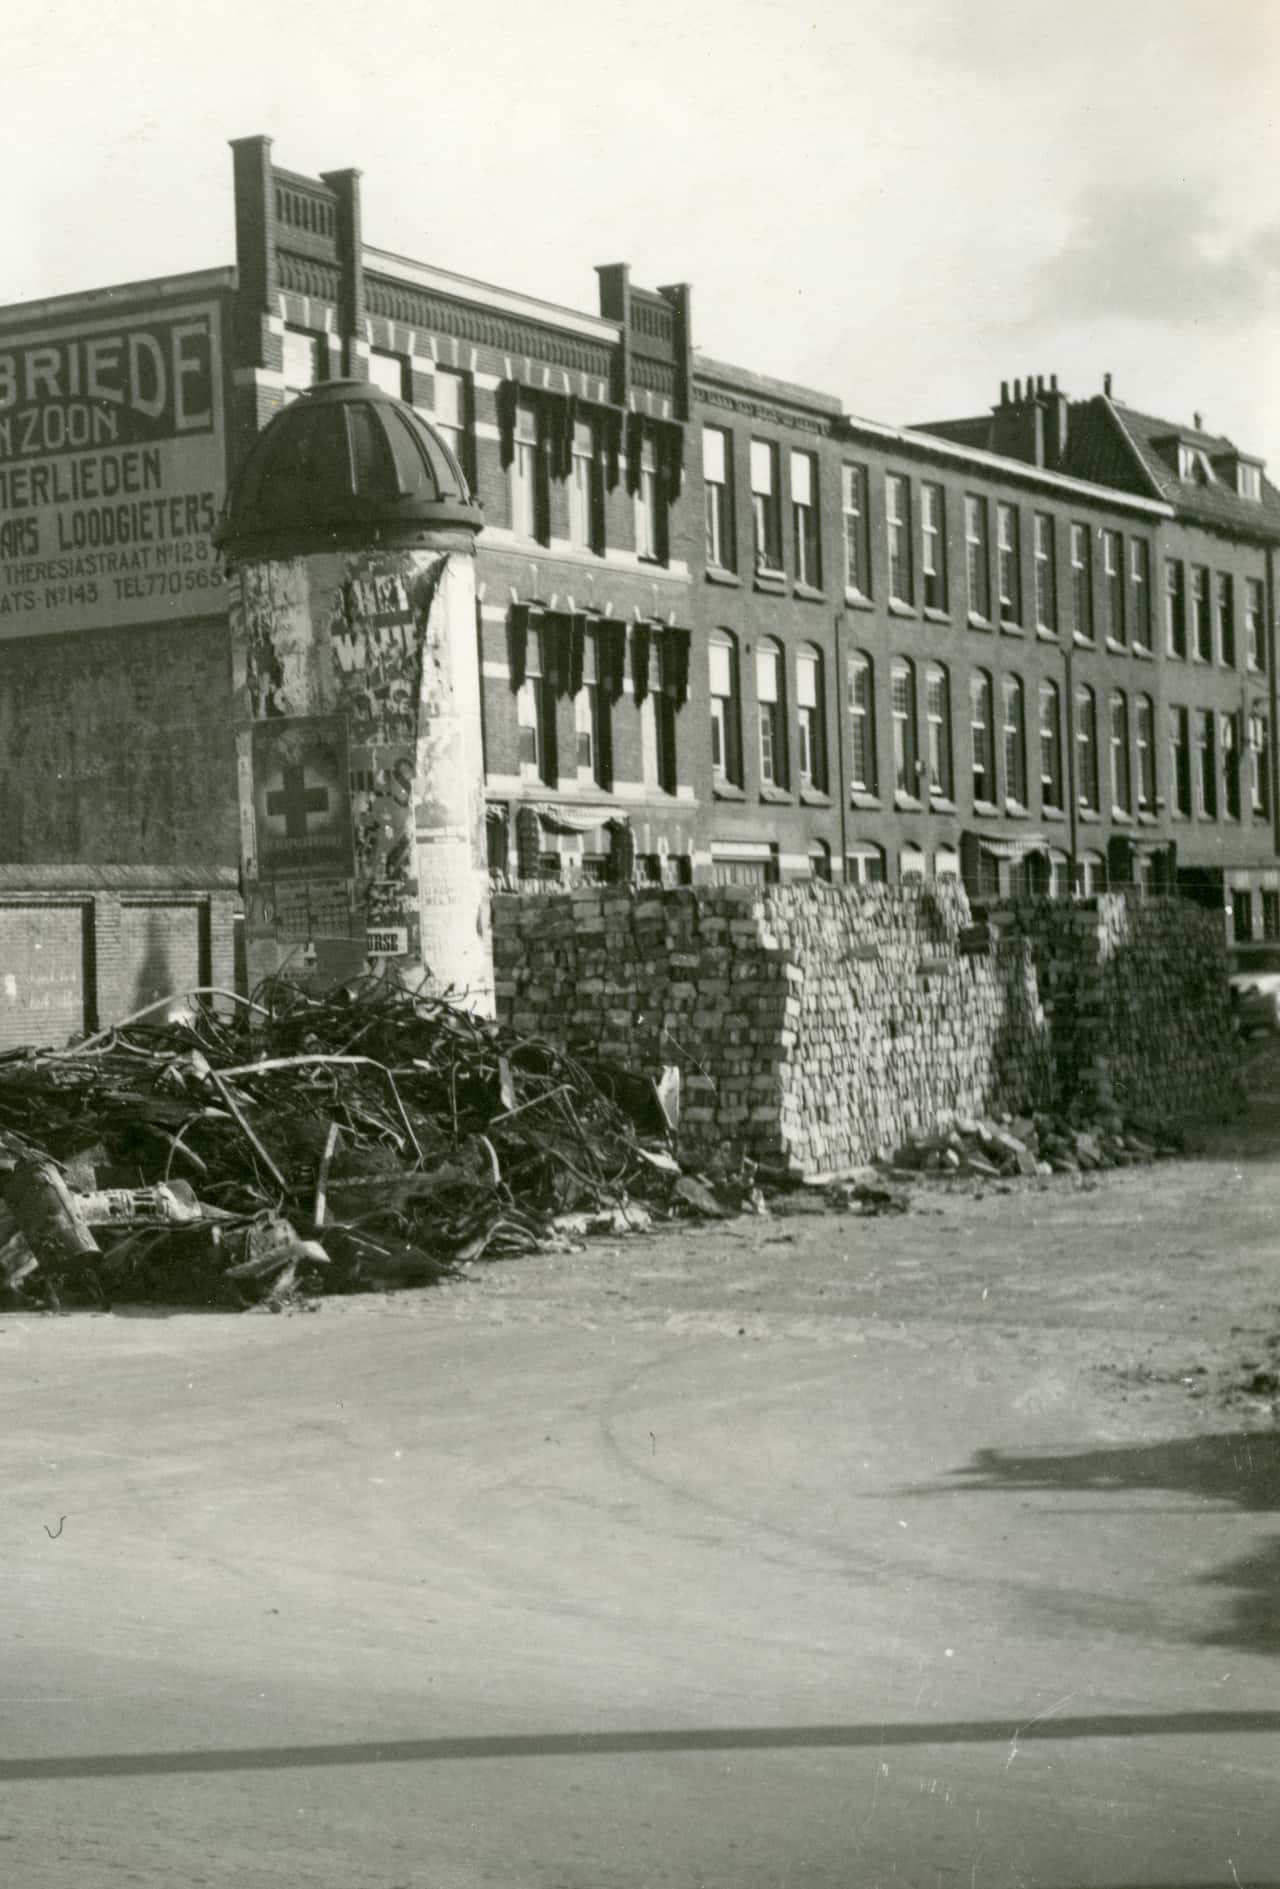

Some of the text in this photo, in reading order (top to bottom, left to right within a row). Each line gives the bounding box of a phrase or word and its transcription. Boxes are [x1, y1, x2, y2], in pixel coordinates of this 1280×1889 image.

[19, 404, 119, 453] ZOON
[57, 492, 216, 551] LOODGIETERS
[4, 546, 151, 585] THERESIASTRAAT
